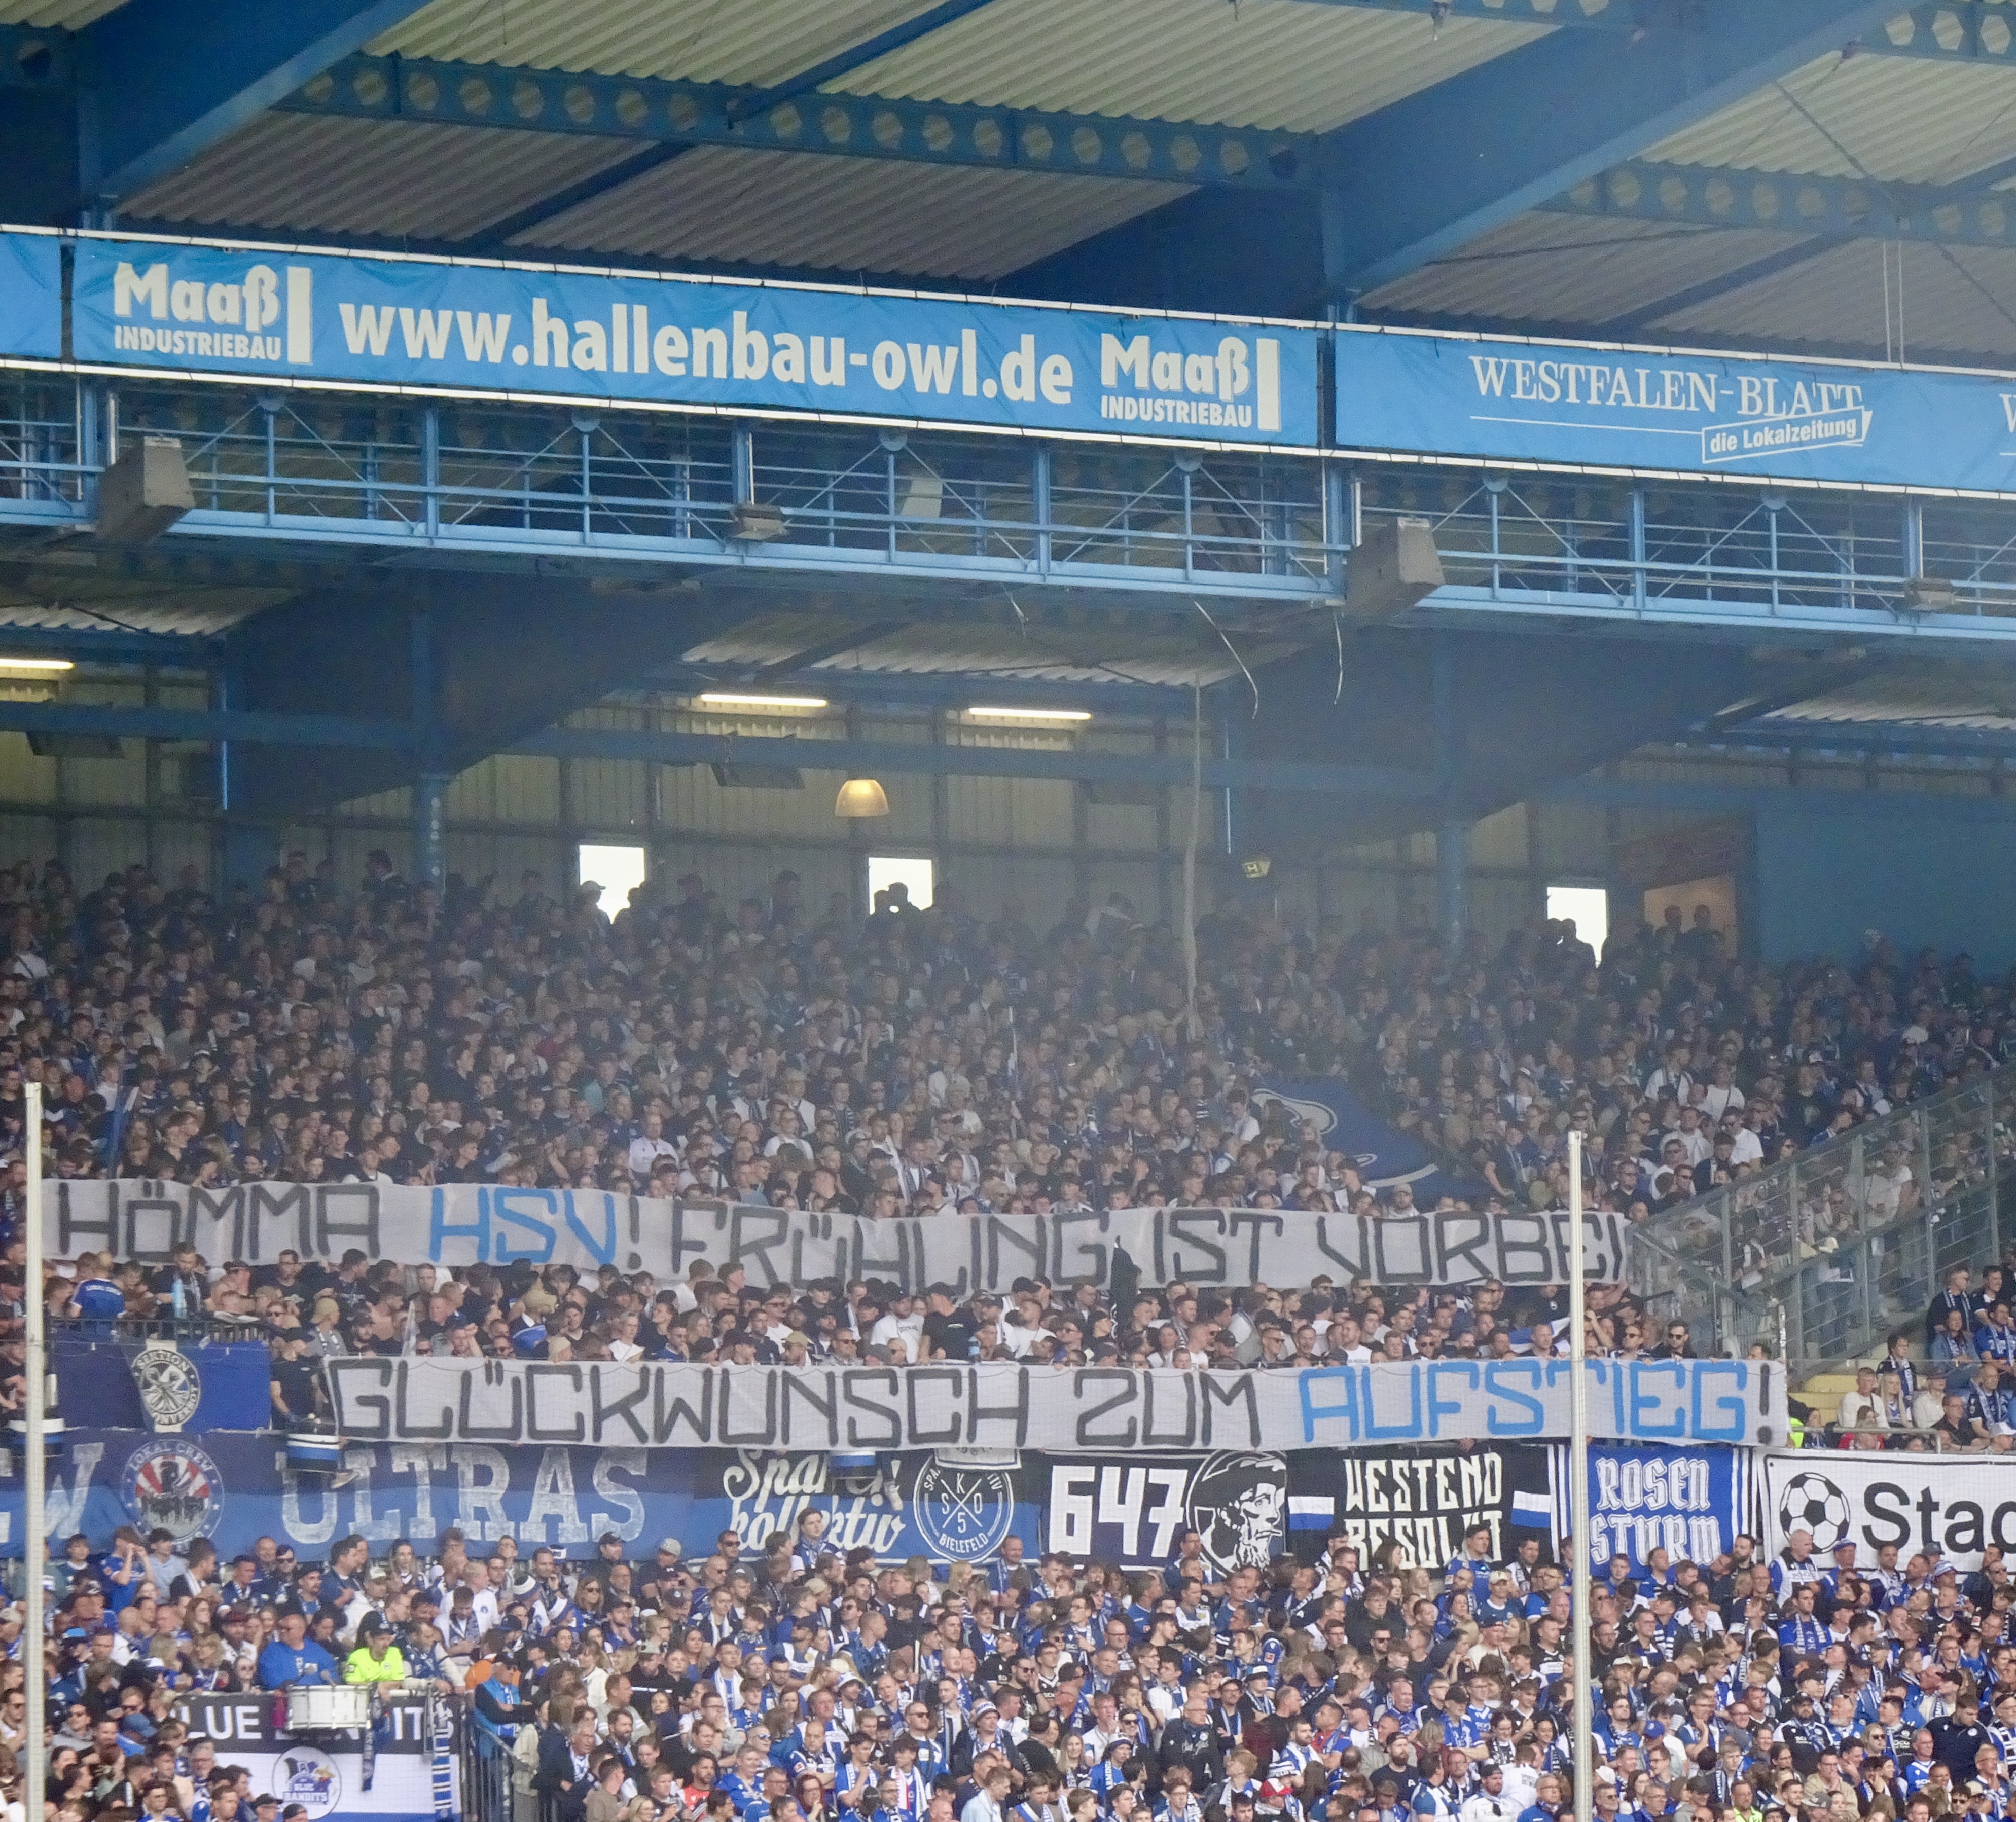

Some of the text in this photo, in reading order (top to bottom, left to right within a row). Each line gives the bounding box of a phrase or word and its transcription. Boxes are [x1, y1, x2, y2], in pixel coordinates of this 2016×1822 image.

[114, 262, 281, 333] Maaß
[115, 325, 281, 361] INDUSTRIEBAU
[338, 298, 1073, 404] www.hallenbau-owl.de
[1101, 333, 1251, 402] Maaß
[1101, 395, 1252, 428] INDUSTRIEBAU
[1468, 355, 1863, 418] WESTFALEN-BLATT
[1710, 418, 1857, 454] die Lokalzeitung
[59, 1180, 380, 1260] HÖMMA
[429, 1187, 643, 1269] HSV!
[672, 1199, 1109, 1296] FRÜHLING
[1154, 1209, 1283, 1283] IST
[328, 1358, 1773, 1448] GLÜCKWUNSCH ZUM AUFSTIEG!
[275, 1445, 648, 1544] ULTRAS
[957, 1473, 965, 1494] K
[1343, 1452, 1502, 1512] WESTEND
[1595, 1457, 1711, 1512] ROSEN
[957, 1512, 966, 1533] 5
[1049, 1465, 1188, 1557] 647
[939, 1533, 989, 1553] BIELEFELD
[169, 1705, 262, 1740] LUE
[283, 1791, 328, 1802] BANDITS
